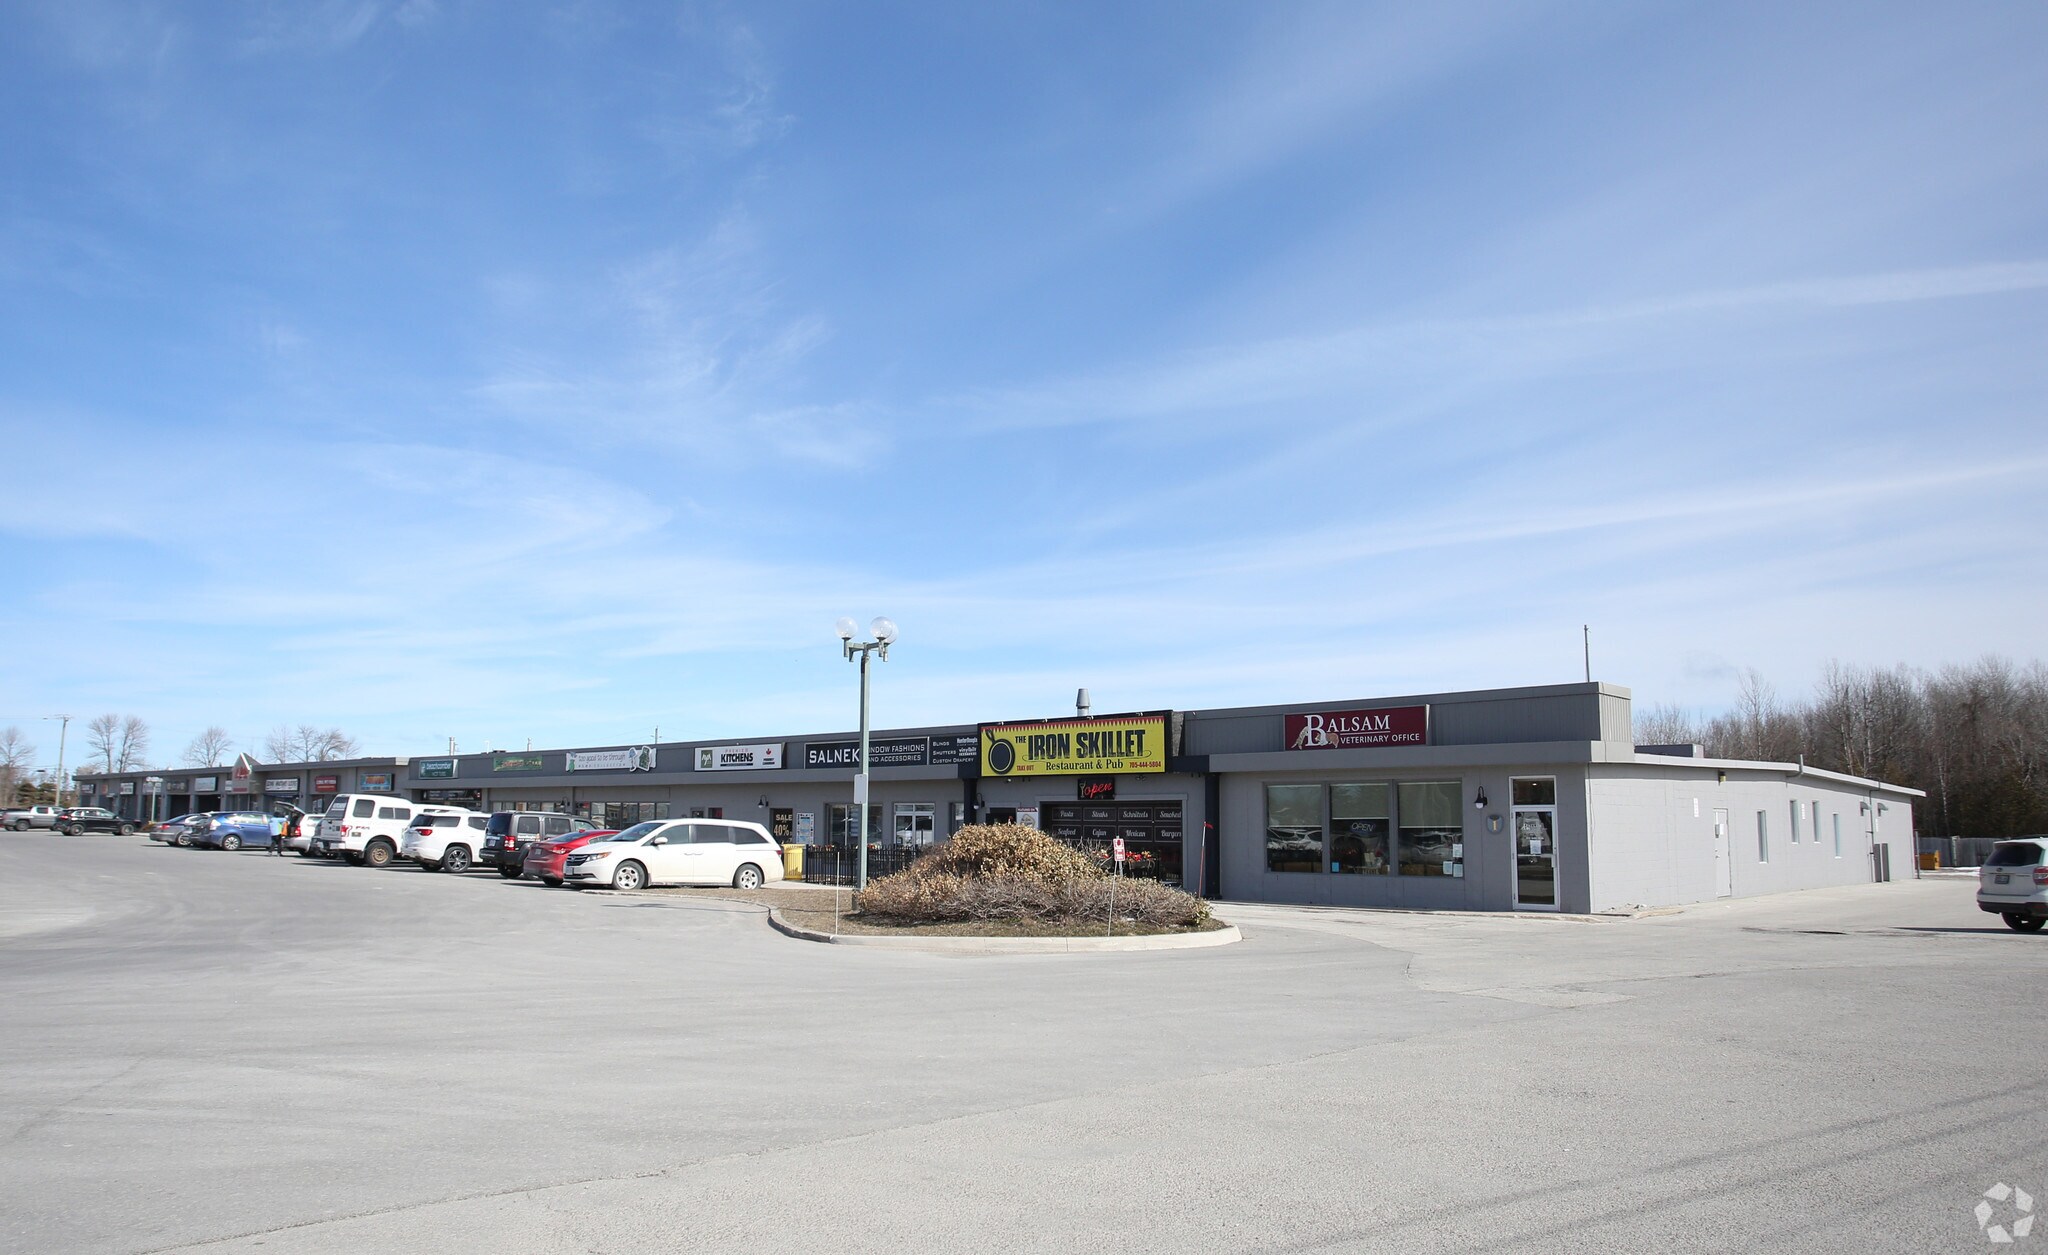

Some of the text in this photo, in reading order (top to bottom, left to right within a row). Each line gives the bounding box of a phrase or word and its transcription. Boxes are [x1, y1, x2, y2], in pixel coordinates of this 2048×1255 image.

[1304, 714, 1391, 747] BALSAM
[1015, 729, 1146, 760] THE IRON SKILLET
[1340, 733, 1420, 744] VETERINARY OFFICE
[891, 744, 925, 752] FASHIONS
[720, 753, 753, 763] KITCHENS
[809, 750, 860, 764] SALNEK
[880, 754, 922, 762] ACCESSORIES
[1045, 758, 1124, 771] Restaurant & Pub
[1084, 783, 1112, 798] open
[1092, 829, 1107, 838] Cajun
